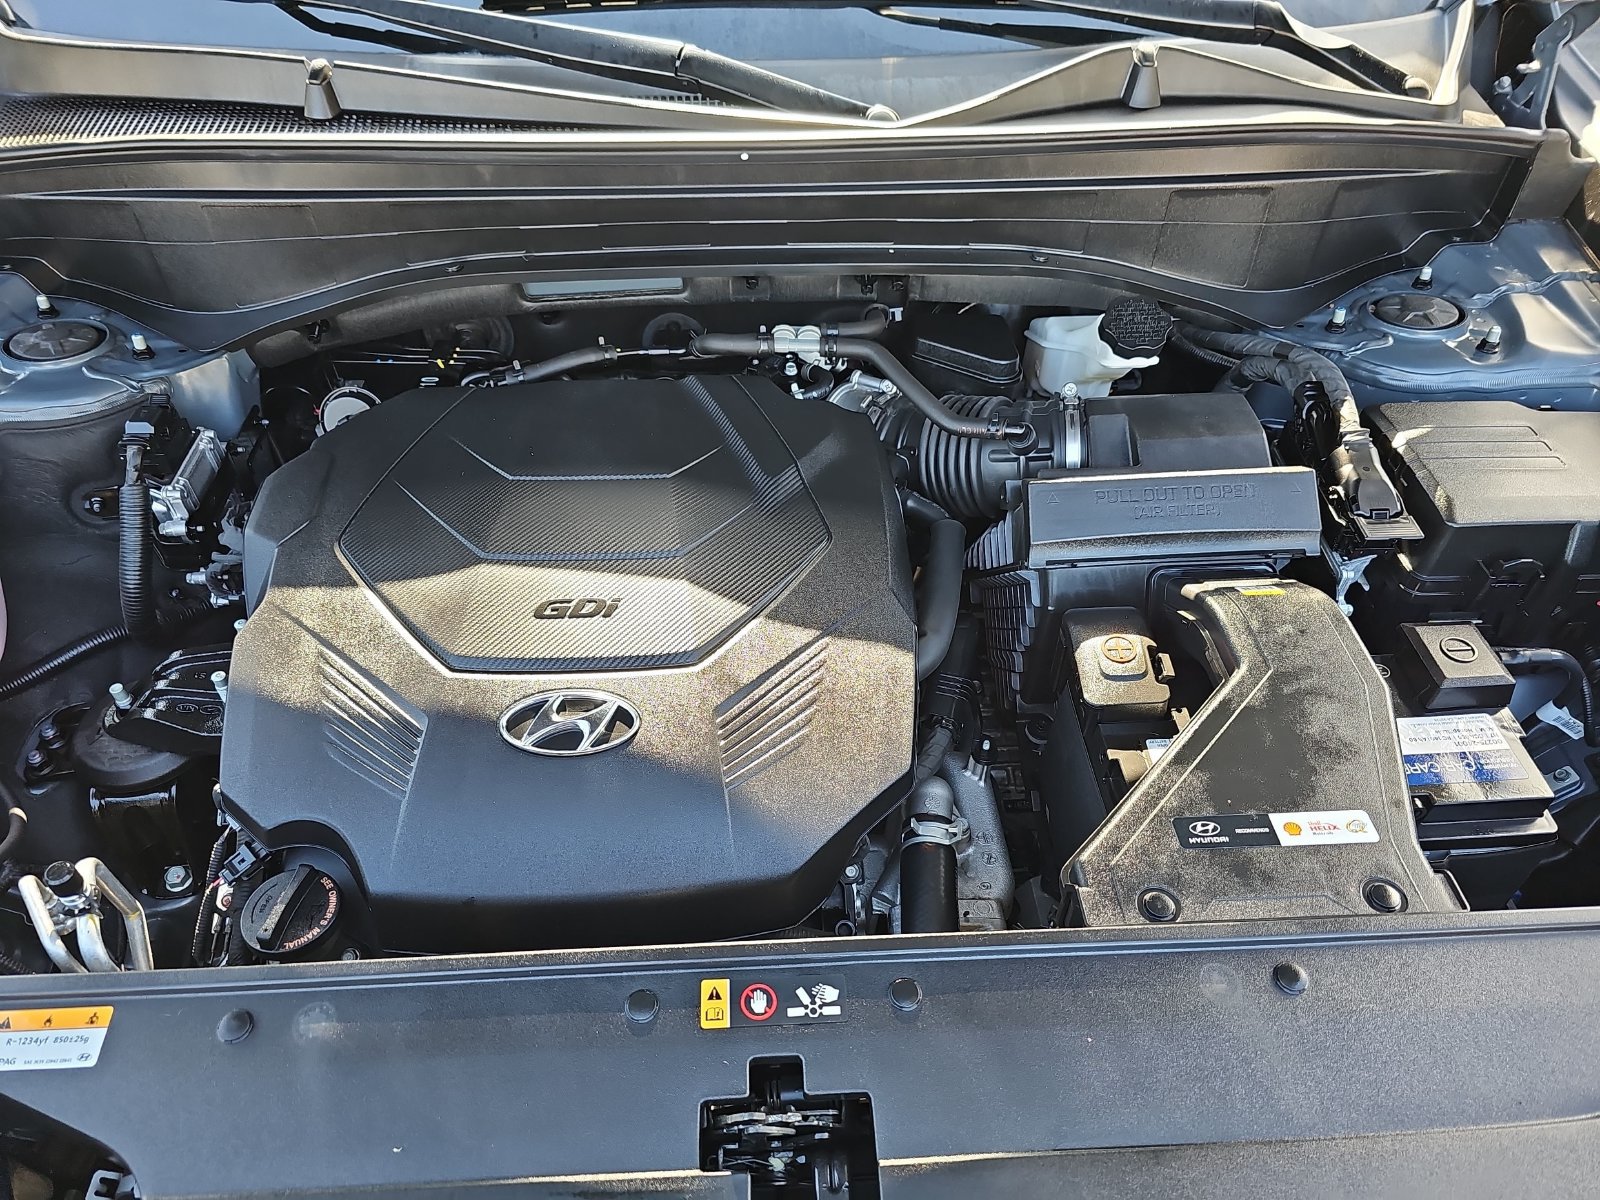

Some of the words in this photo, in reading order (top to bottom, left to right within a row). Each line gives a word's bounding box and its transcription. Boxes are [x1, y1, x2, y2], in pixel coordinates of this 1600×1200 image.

[1094, 488, 1140, 503] PULL
[1144, 486, 1178, 501] OUT
[1182, 484, 1205, 500] TO
[1210, 482, 1257, 499] OPEN
[1134, 505, 1163, 520] (AIR
[1167, 503, 1223, 518] FILTER)
[534, 598, 622, 619] GDi
[1188, 836, 1230, 844] HYUNDAI
[320, 876, 334, 890] SEE
[319, 890, 338, 926] OWNER'S
[283, 926, 321, 950] MANUAL
[5, 1035, 50, 1046] R-1234yf
